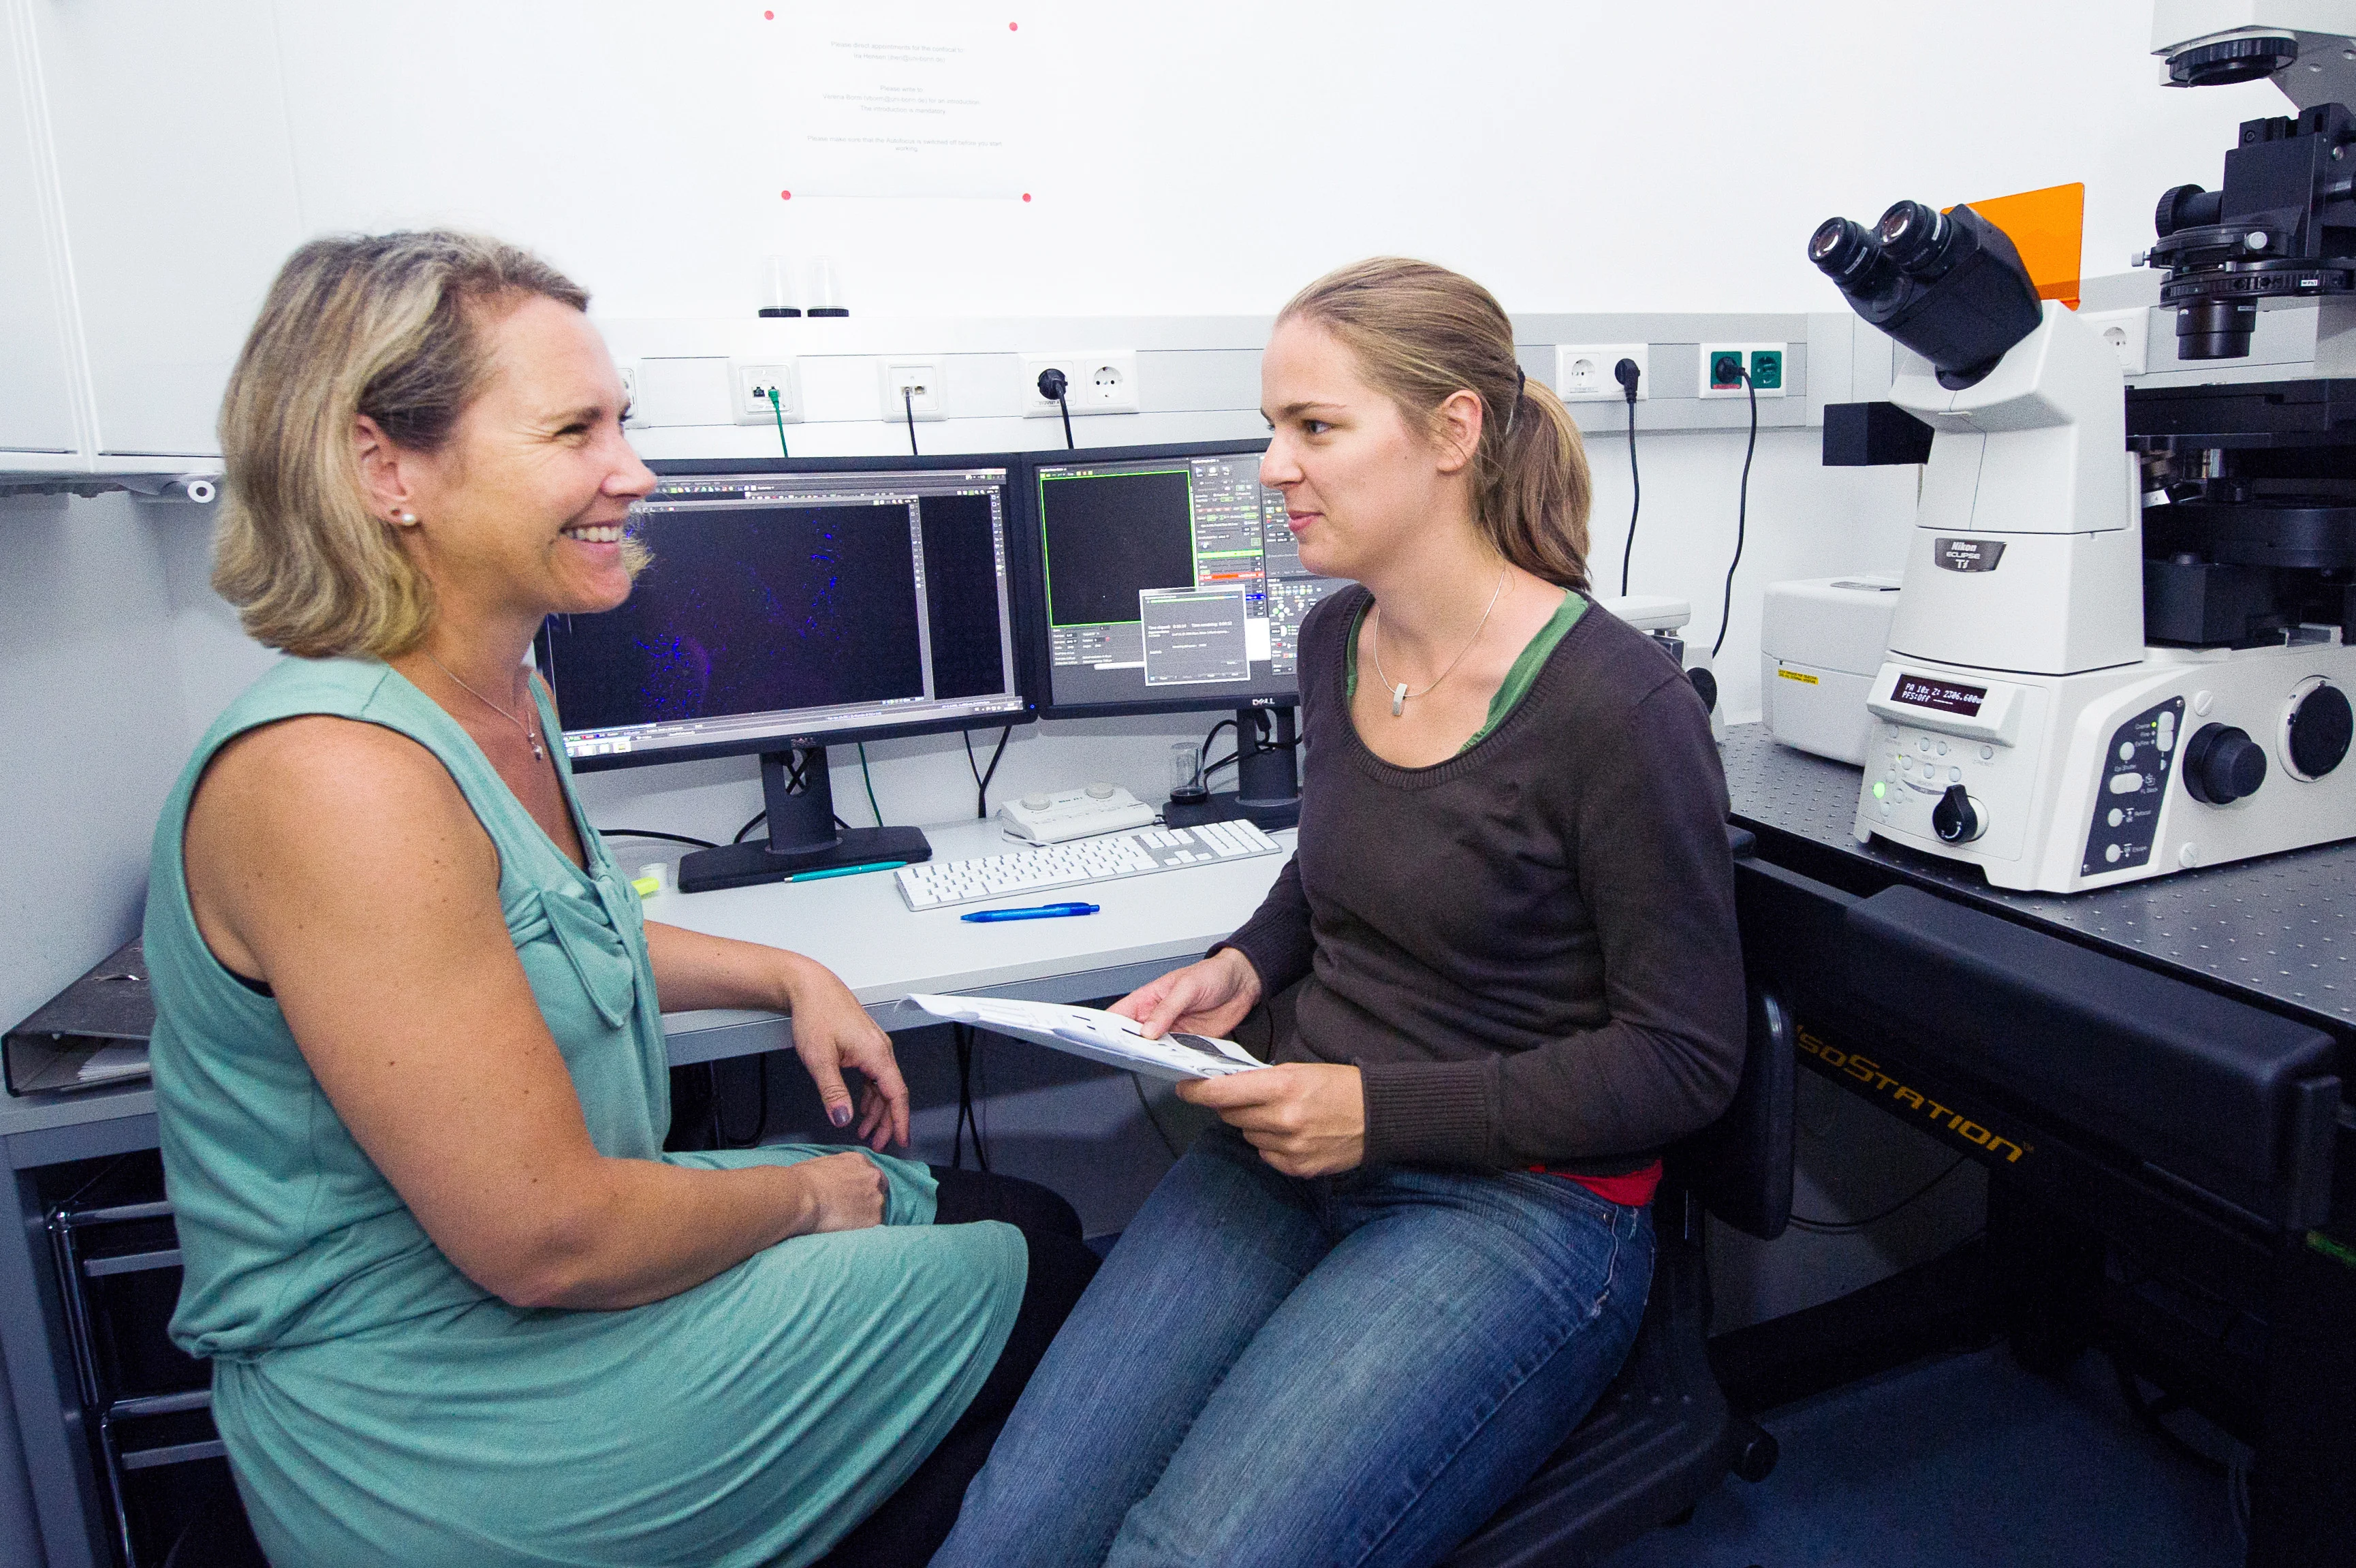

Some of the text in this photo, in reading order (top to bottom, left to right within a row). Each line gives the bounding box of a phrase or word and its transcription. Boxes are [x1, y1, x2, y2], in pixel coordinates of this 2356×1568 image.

[1951, 542, 1977, 552] Nikon
[1956, 559, 1970, 569] Ti
[1905, 683, 1915, 691] PA
[1917, 685, 1929, 694] 10x
[1932, 688, 1941, 696] Z:
[1252, 697, 1275, 706] DELL
[791, 737, 816, 747] DELL
